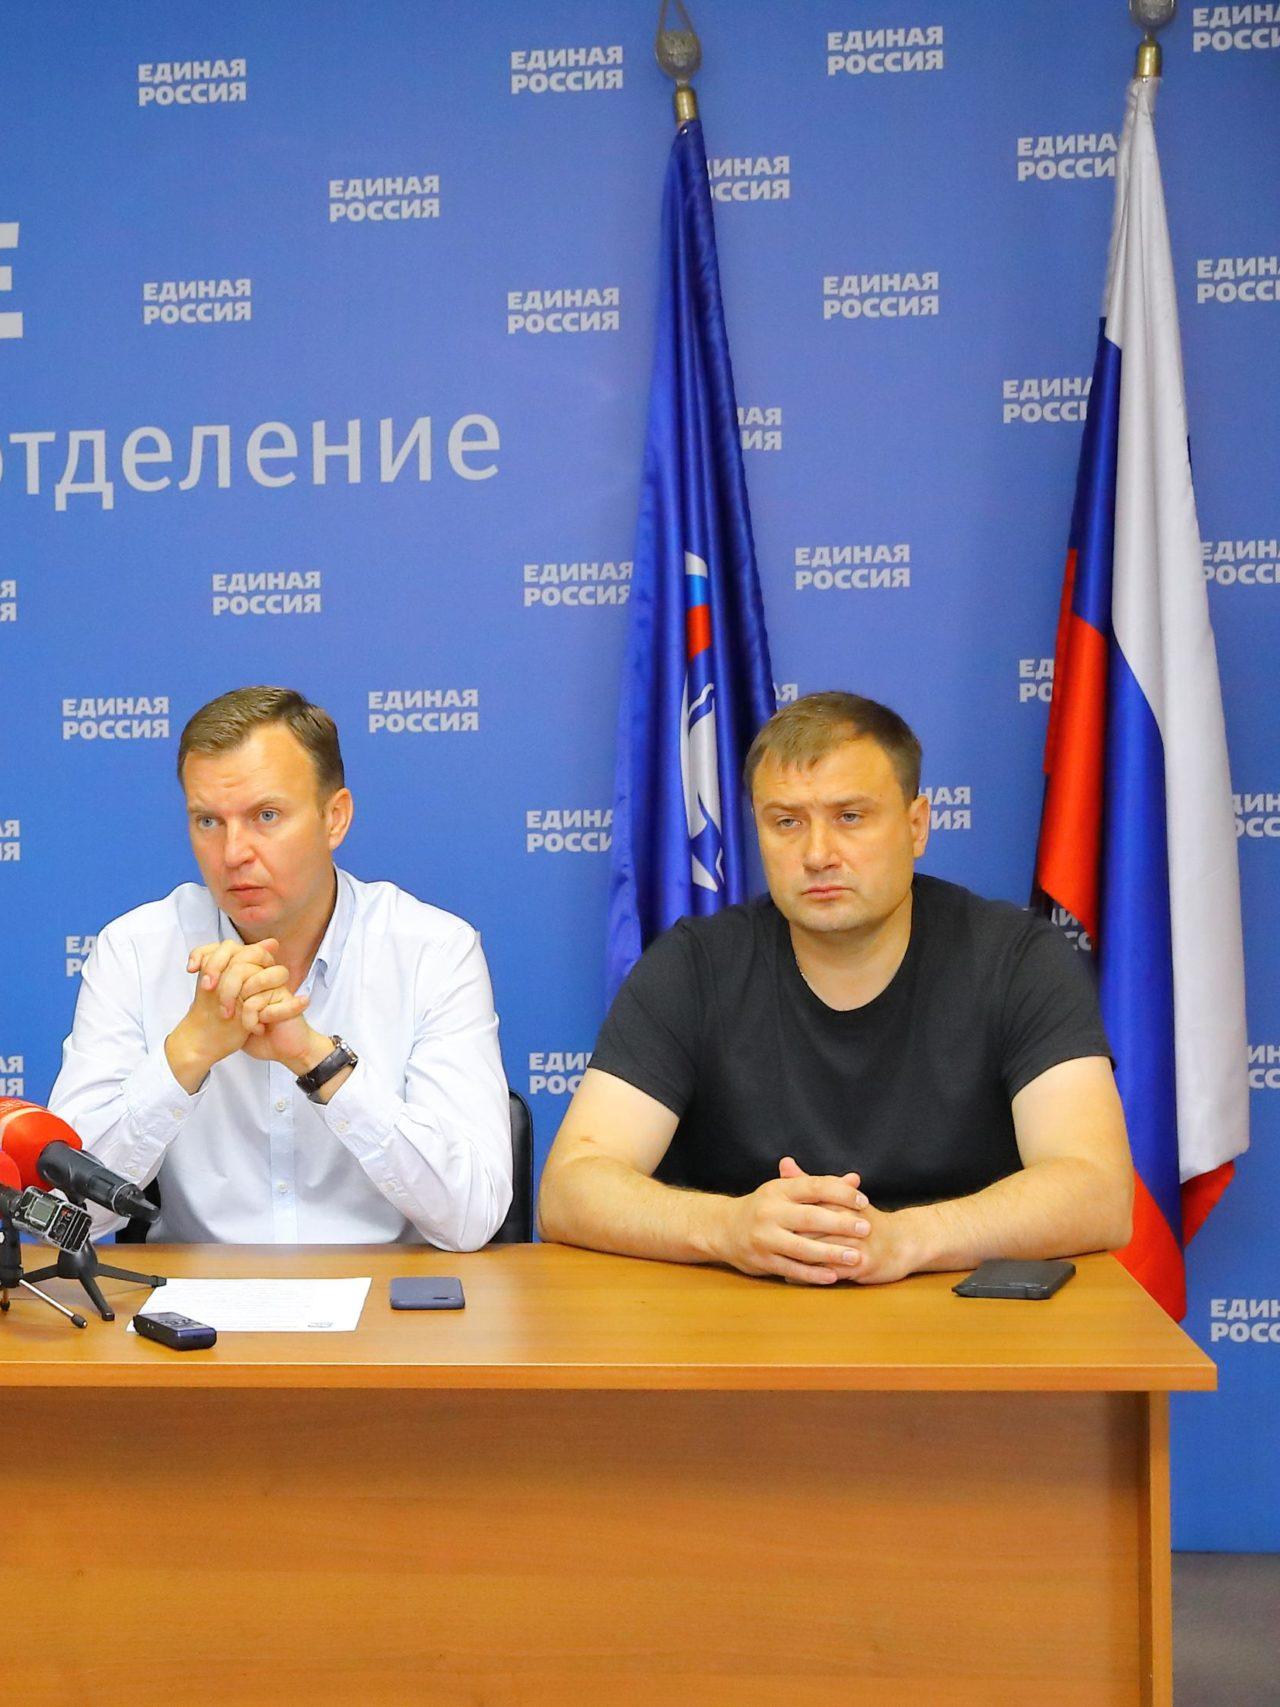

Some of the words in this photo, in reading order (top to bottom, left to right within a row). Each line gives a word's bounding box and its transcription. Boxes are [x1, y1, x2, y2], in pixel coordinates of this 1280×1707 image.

[1192, 4, 1280, 28] ЕДИН
[828, 26, 943, 52] ЕДИНАЯ
[1193, 28, 1280, 52] РОСС
[511, 46, 623, 71] ЕДИНАЯ
[828, 50, 943, 75] РОССИЯ
[139, 59, 246, 84] ЕДИНАЯ
[512, 70, 623, 94] РОССИЯ
[139, 82, 246, 106] РОССИЯ
[1017, 133, 1117, 158] ЕДИНА
[708, 155, 790, 180] ИНАЯ
[1017, 157, 1116, 182] РОССИ
[330, 175, 439, 200] ЕДИНАЯ
[711, 179, 791, 202] ССИЯ
[330, 198, 439, 222] РОССИЯ
[1197, 256, 1280, 281] ЕДИН
[144, 279, 251, 303] ЕДИНАЯ
[824, 272, 938, 296] ЕДИНАЯ
[1197, 279, 1280, 304] РОСС
[508, 288, 619, 312] ЕДИНАЯ
[824, 296, 938, 319] РОССИЯ
[144, 301, 251, 324] РОССИЯ
[508, 311, 619, 334] РОССИЯ
[1003, 377, 1092, 400] ЕДИН
[1003, 400, 1087, 424] РОСС
[795, 544, 910, 568] ЕДИНАЯ
[1200, 540, 1280, 562] ЕДИН
[213, 571, 320, 593] ЕДИНАЯ
[796, 568, 910, 590] РОССИЯ
[213, 594, 321, 615] РОССИЯ
[63, 697, 169, 718] ЕДИНАЯ
[369, 689, 478, 711] ЕДИНАЯ
[63, 719, 169, 739] РОССИЯ
[369, 712, 478, 733] РОССИЯ
[526, 810, 613, 831] ЕДИНА
[527, 831, 612, 853] РОССИ
[1210, 1299, 1280, 1320] ЕДИН
[1210, 1322, 1280, 1344] РОСС
